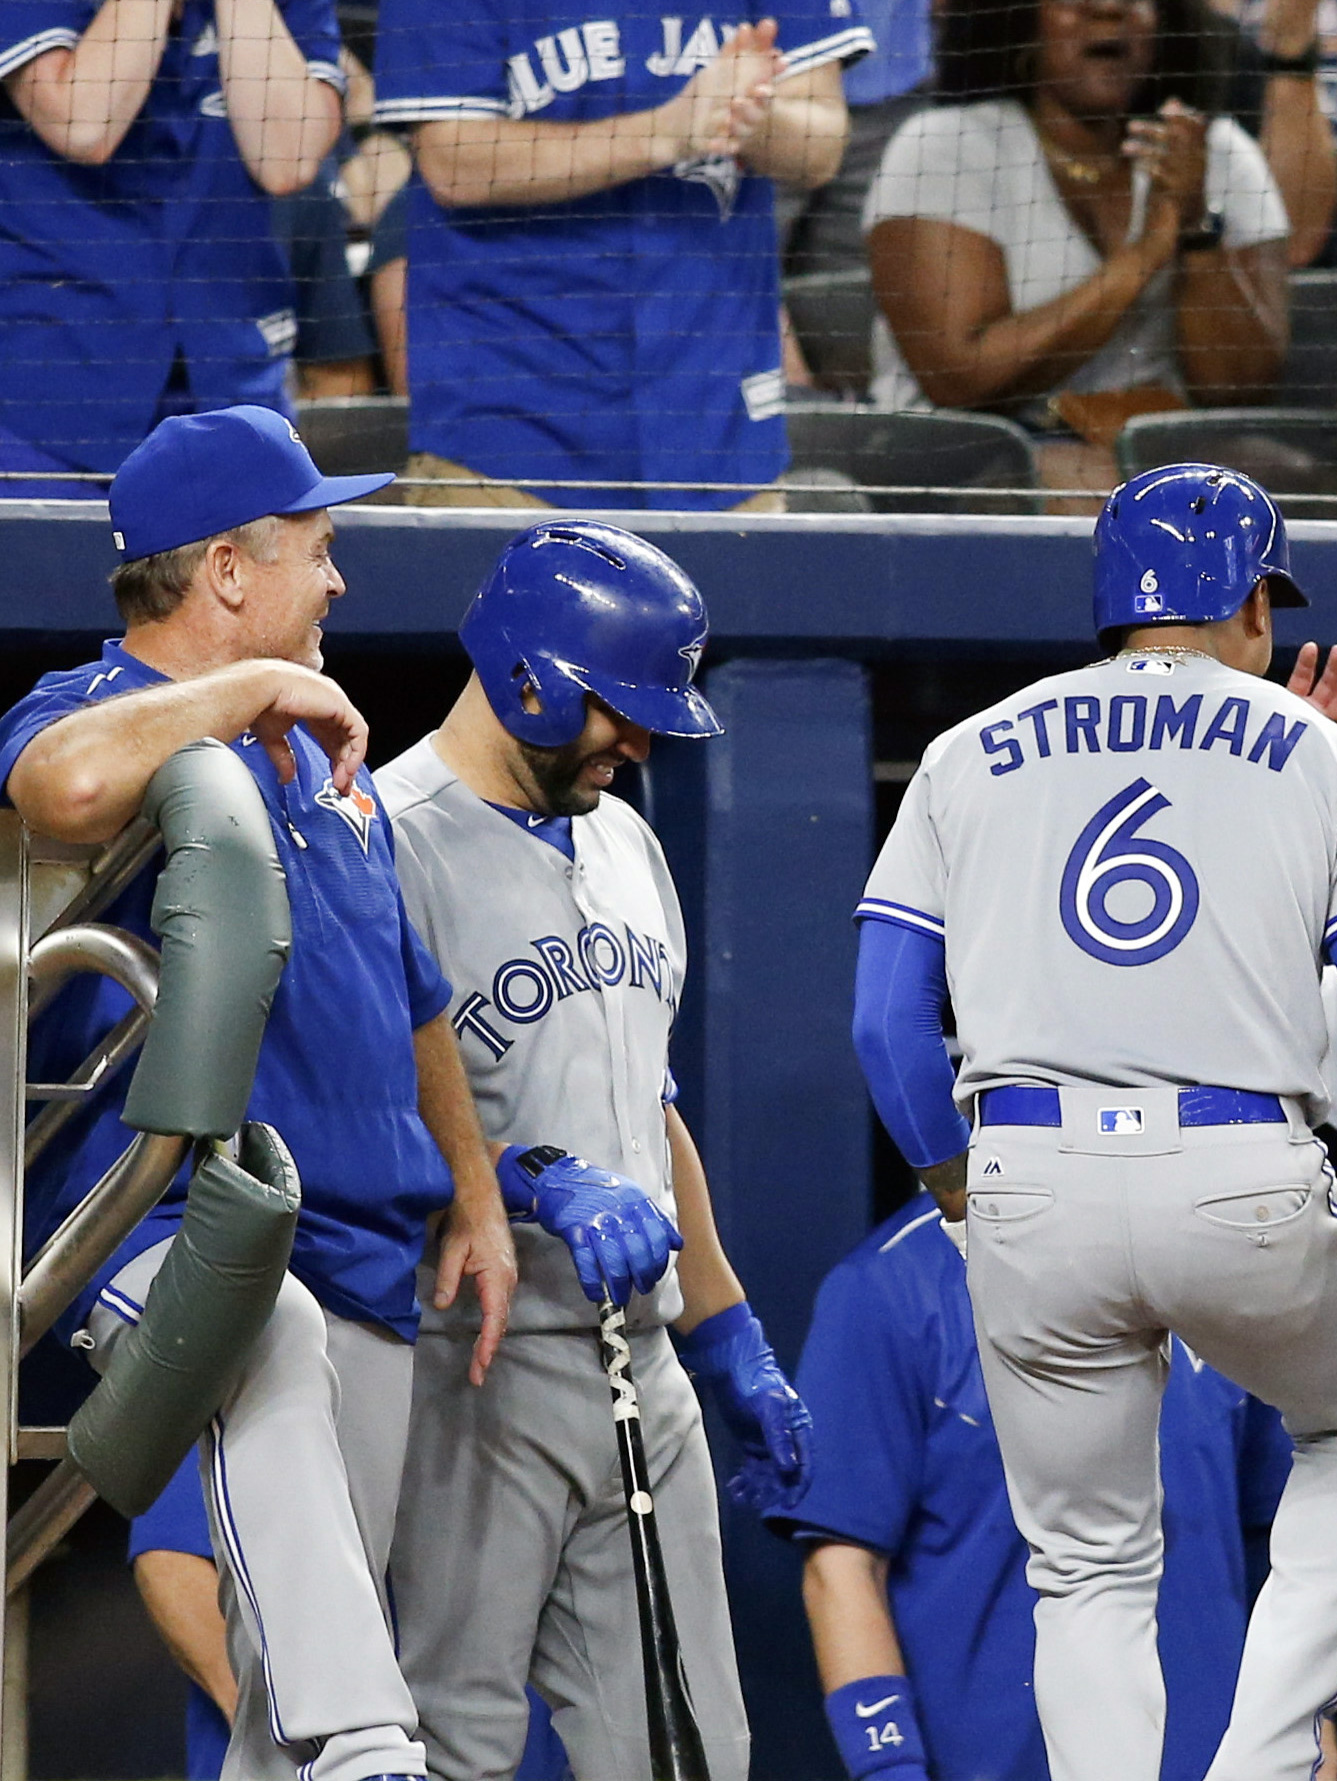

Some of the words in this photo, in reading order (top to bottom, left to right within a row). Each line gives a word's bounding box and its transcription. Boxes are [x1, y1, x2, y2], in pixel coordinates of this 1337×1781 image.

[1140, 568, 1159, 594] 6
[979, 694, 1308, 777] STROMAN
[1059, 776, 1200, 967] 6
[865, 1721, 904, 1752] 14
